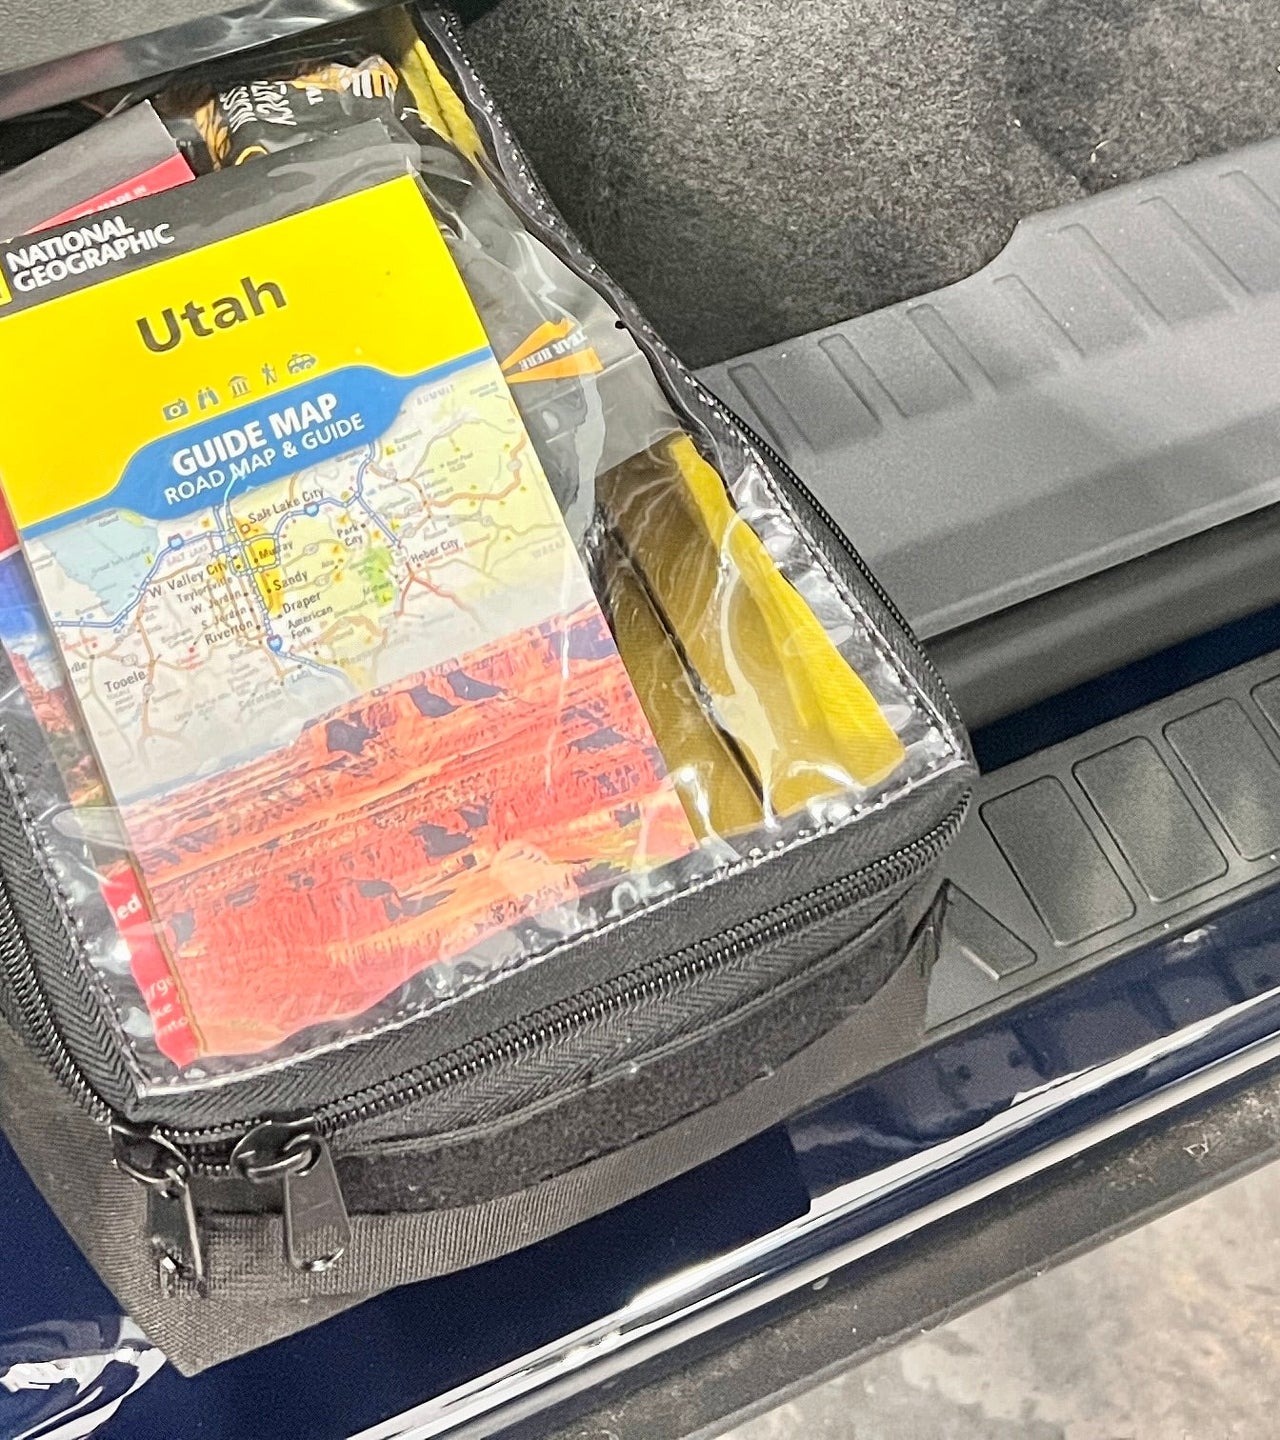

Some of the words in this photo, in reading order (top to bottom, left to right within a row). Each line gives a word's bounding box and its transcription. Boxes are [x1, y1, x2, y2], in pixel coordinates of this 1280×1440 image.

[5, 215, 135, 273] NATIONAL
[13, 223, 175, 292] GEOGRAPHIC
[136, 276, 287, 353] Utah
[172, 420, 267, 477] GUIDE
[269, 392, 338, 440] MAP
[164, 469, 225, 505] ROAD
[229, 448, 276, 481] MAP
[282, 441, 299, 459] &
[301, 413, 365, 450] GUIDE
[248, 507, 271, 524] Salt
[272, 499, 301, 514] Lake
[302, 487, 324, 502] City
[167, 570, 204, 591] Valley
[273, 570, 308, 591] Sandy
[282, 591, 321, 614] Draper
[287, 605, 333, 630] American
[205, 620, 253, 645] Riverton
[104, 670, 146, 693] Tooele
